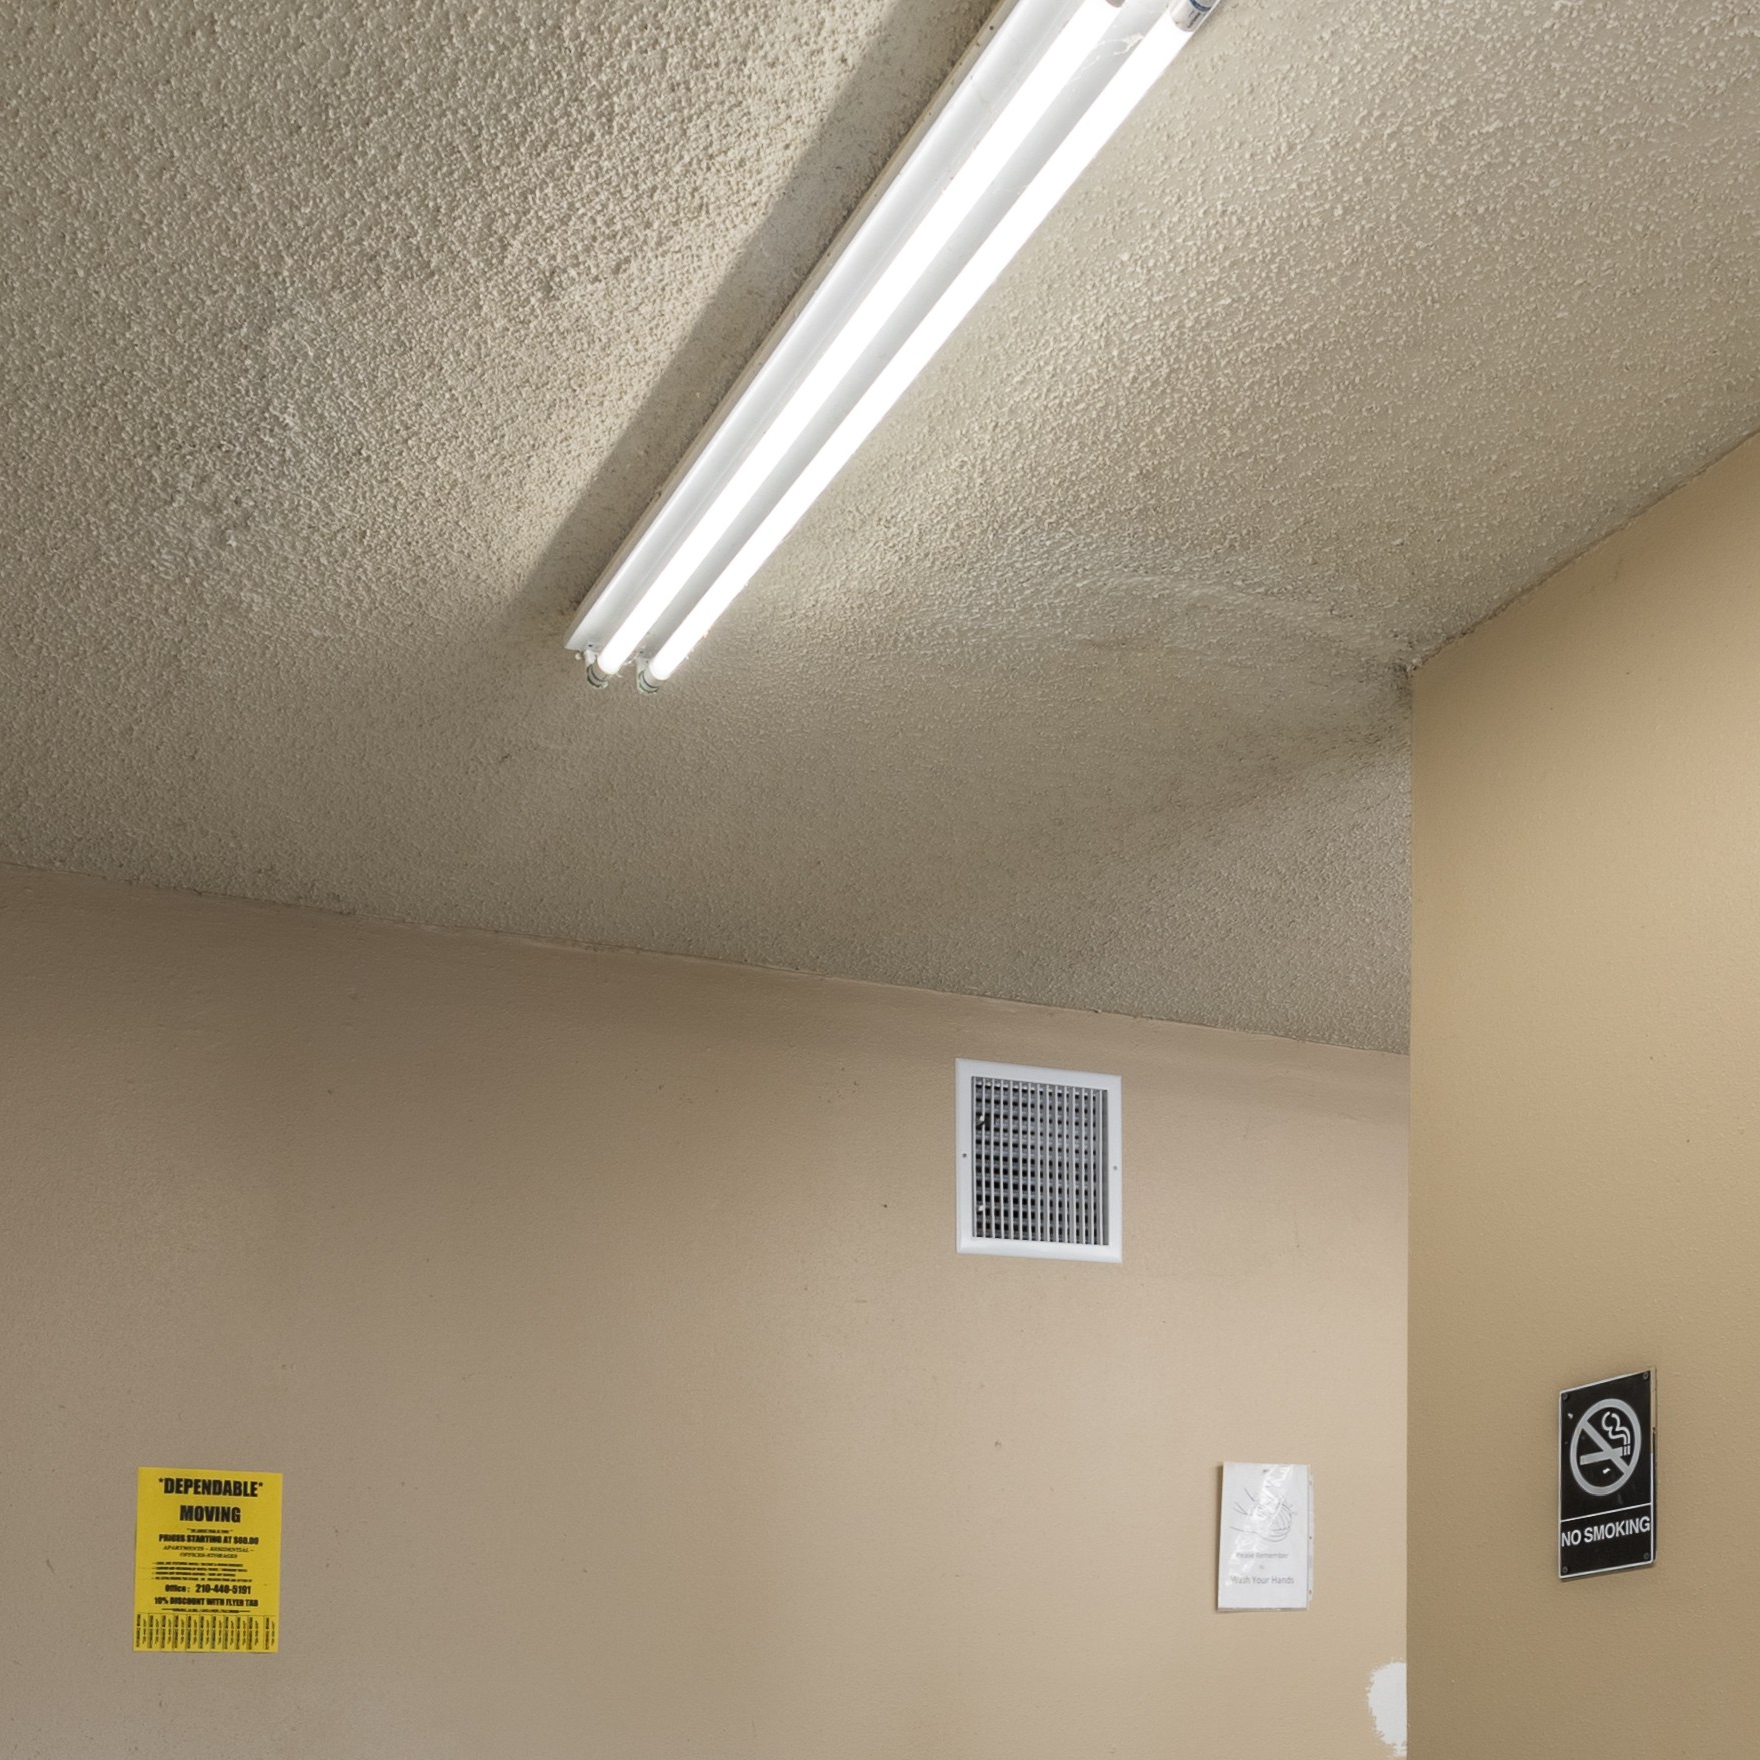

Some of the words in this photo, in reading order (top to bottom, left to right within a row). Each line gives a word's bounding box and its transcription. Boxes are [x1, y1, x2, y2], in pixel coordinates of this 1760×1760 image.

[179, 1504, 241, 1523] MOVING
[1561, 1529, 1582, 1547] NO
[1584, 1515, 1651, 1543] SMOKING
[159, 1534, 185, 1542] PRICES
[187, 1534, 222, 1543] STARTING
[223, 1536, 232, 1544] AT
[1252, 1575, 1269, 1584] Your
[1271, 1575, 1294, 1584] Hands
[165, 1584, 186, 1592] Office
[169, 1597, 205, 1605] DISCOUNT
